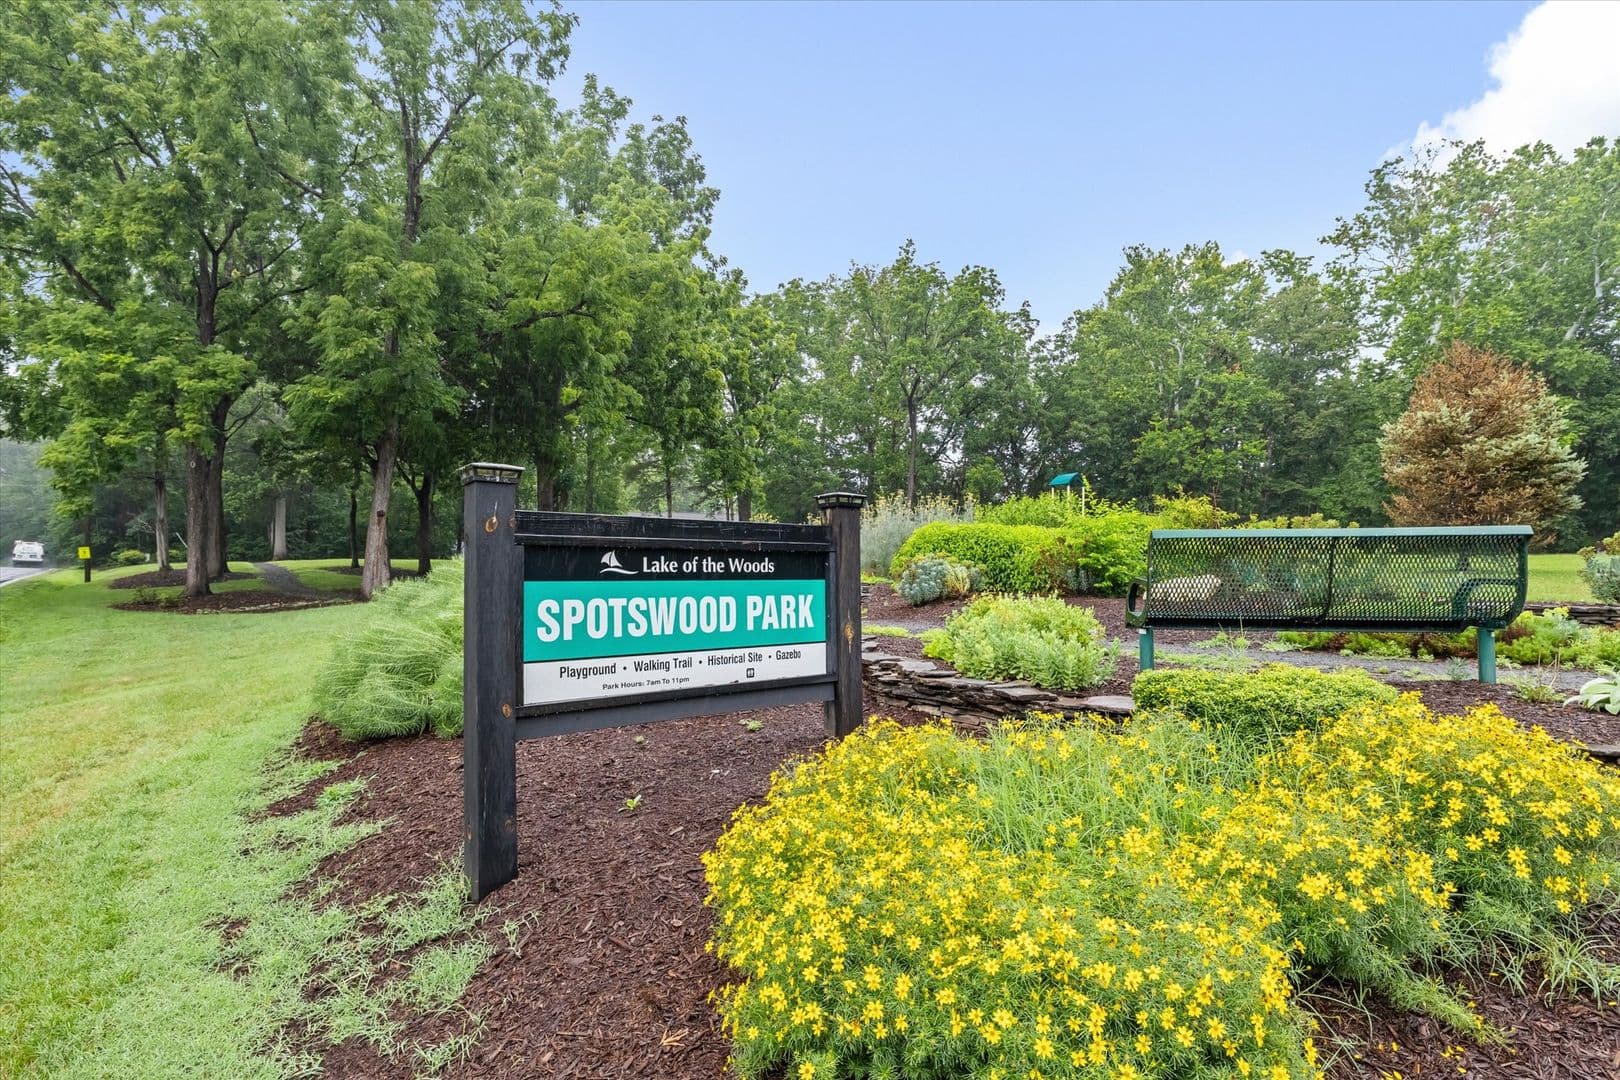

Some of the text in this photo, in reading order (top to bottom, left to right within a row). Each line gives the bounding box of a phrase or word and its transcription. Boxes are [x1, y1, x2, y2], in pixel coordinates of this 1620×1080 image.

[642, 555, 775, 572] Lake of the Woods
[537, 594, 814, 642] SPOTSWOOD PARK
[559, 649, 801, 679] Playground Walking Trail Historical Site Gazebo
[672, 677, 689, 685] 11pm
